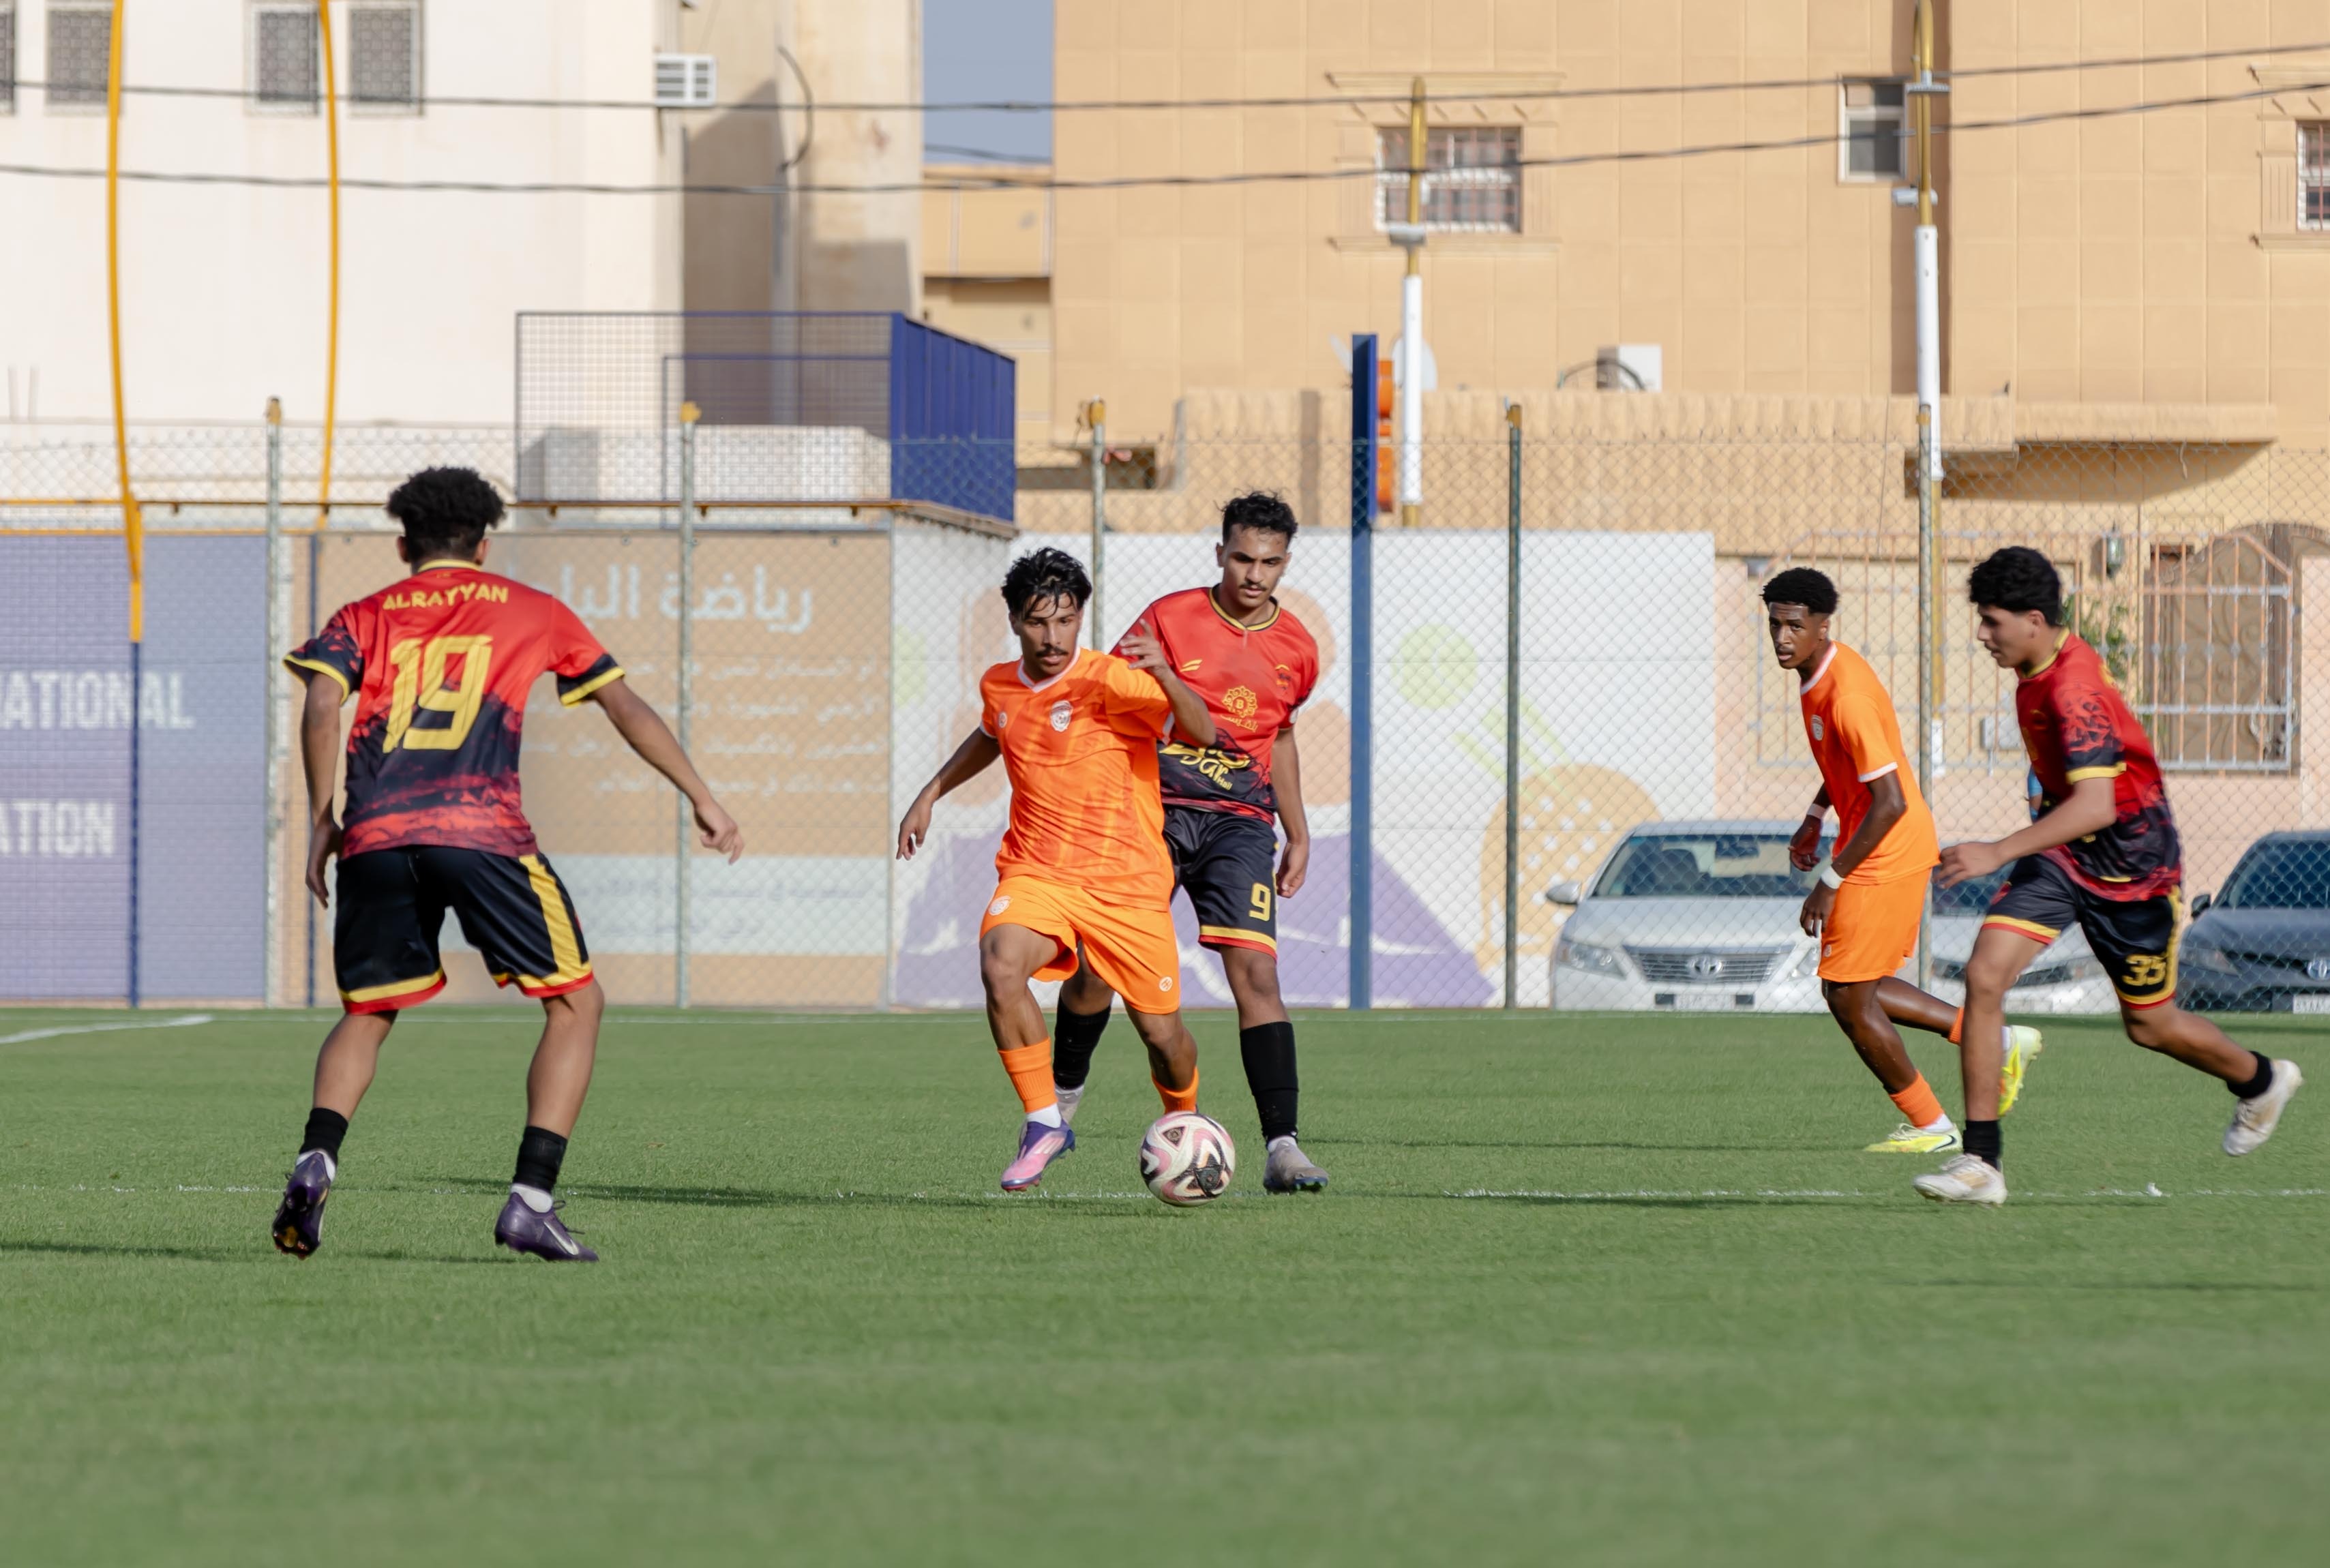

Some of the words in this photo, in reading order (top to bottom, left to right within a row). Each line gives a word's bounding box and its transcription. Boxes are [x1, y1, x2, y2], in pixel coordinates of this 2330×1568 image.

[382, 582, 509, 610] ALRAYYAN
[505, 561, 641, 632] البا
[658, 563, 813, 635] رياضة
[0, 669, 196, 730] ATIONAL
[382, 633, 494, 754] 19
[1249, 882, 1271, 922] 9
